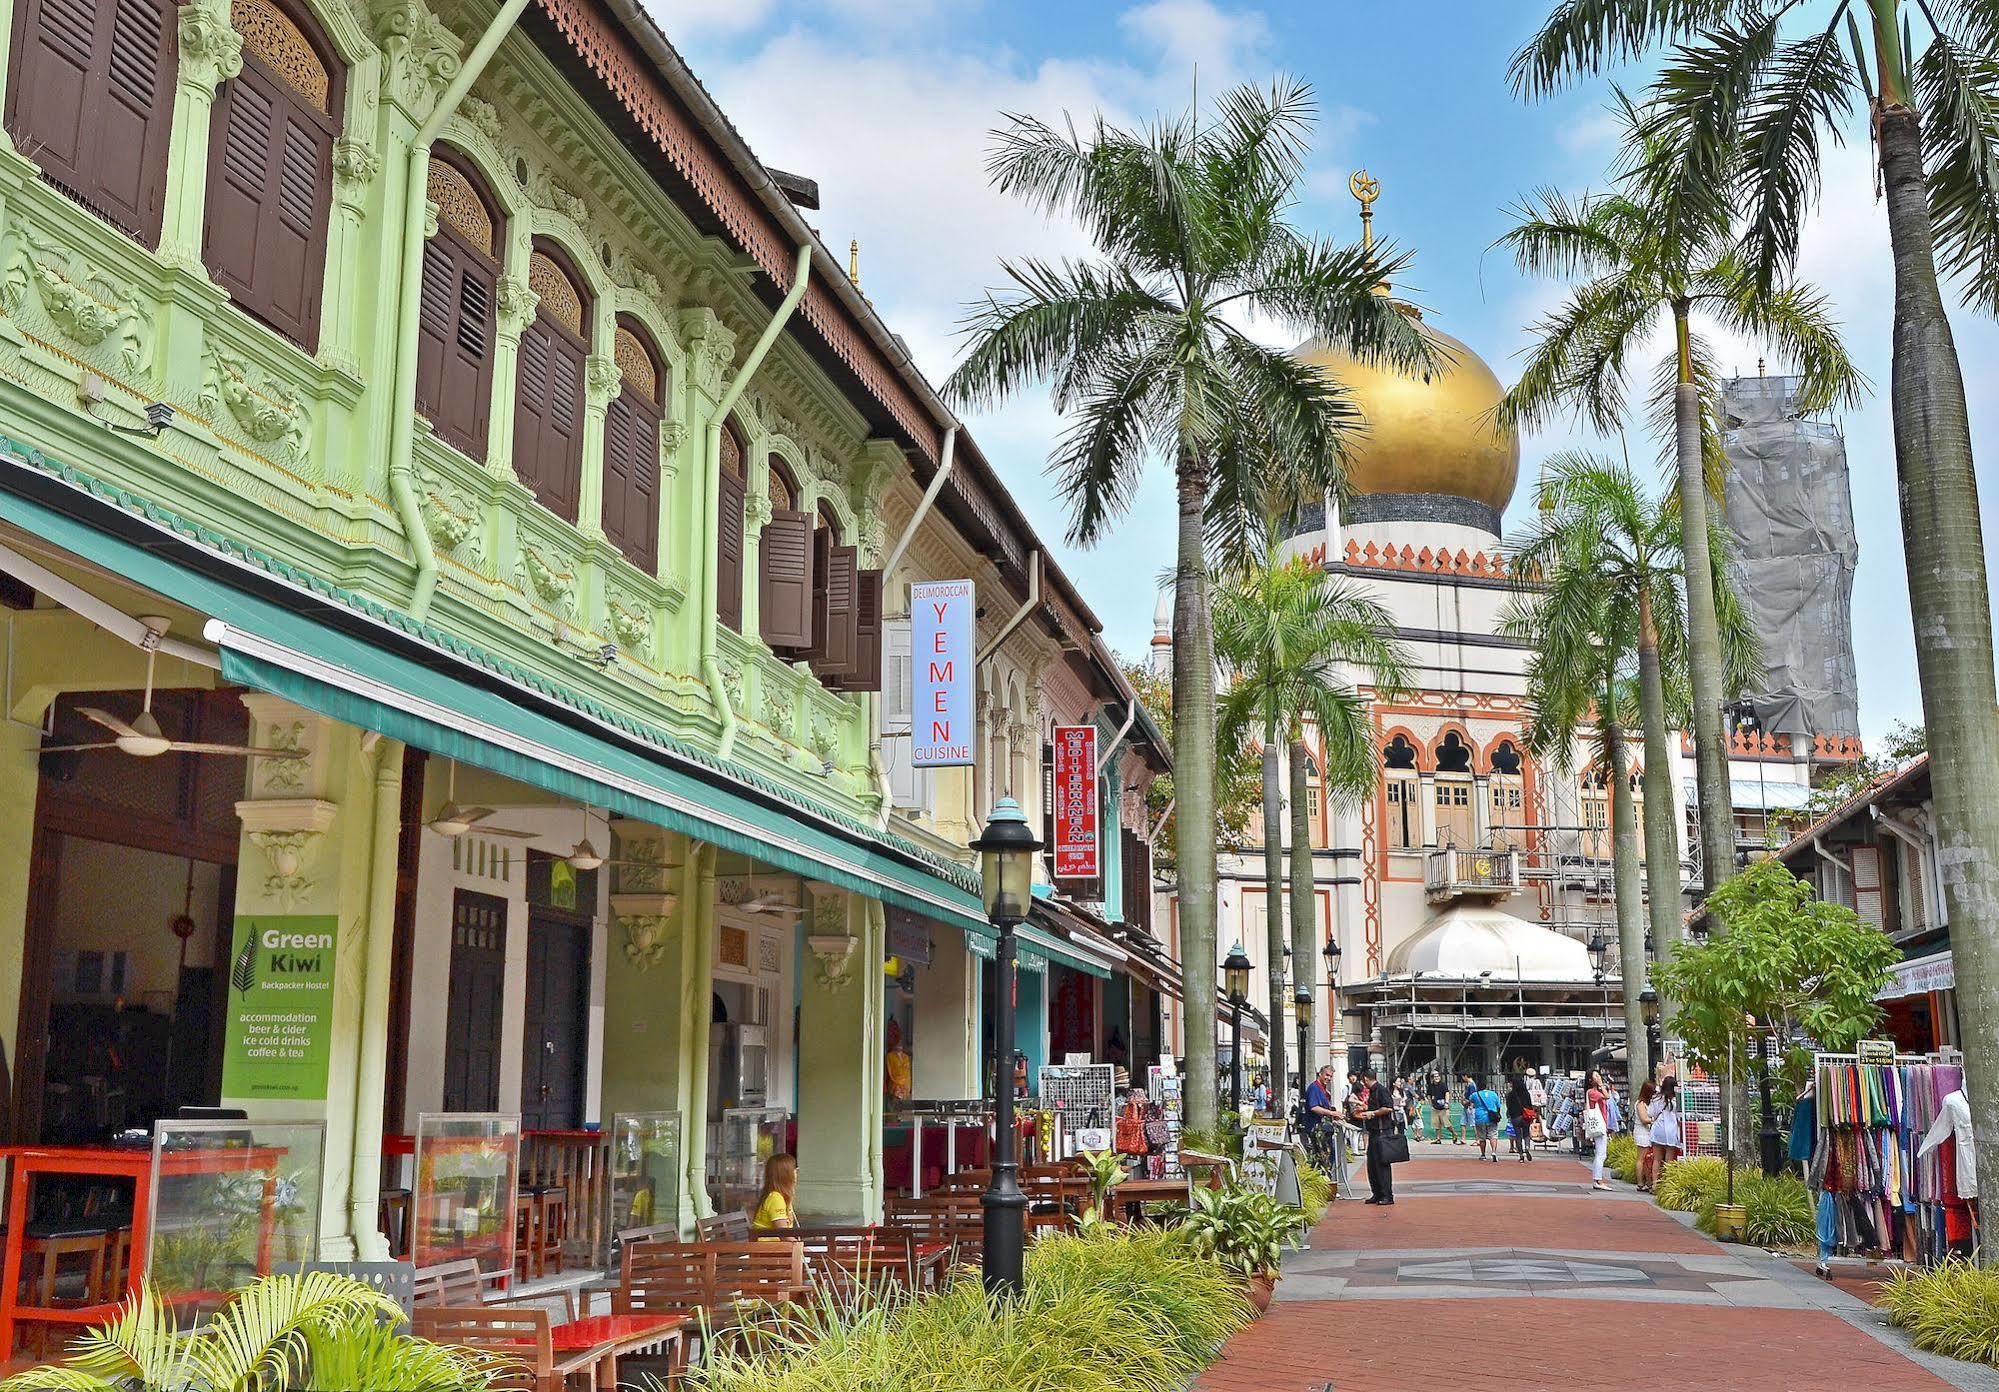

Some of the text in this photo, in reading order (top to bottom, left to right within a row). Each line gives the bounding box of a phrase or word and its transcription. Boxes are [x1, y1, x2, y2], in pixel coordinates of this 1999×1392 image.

[930, 602, 953, 743] YEMEN
[914, 746, 969, 760] CUISINE
[1064, 730, 1085, 843] MEDITERRANEAN
[262, 929, 333, 949] Green
[271, 953, 321, 973] Kiwi
[261, 981, 329, 992] Backpacker Hostel
[239, 1013, 317, 1023] accommodation
[249, 1024, 307, 1034] beer & cider
[243, 1036, 311, 1046] ice cold drinks
[247, 1047, 305, 1057] coffee & tea
